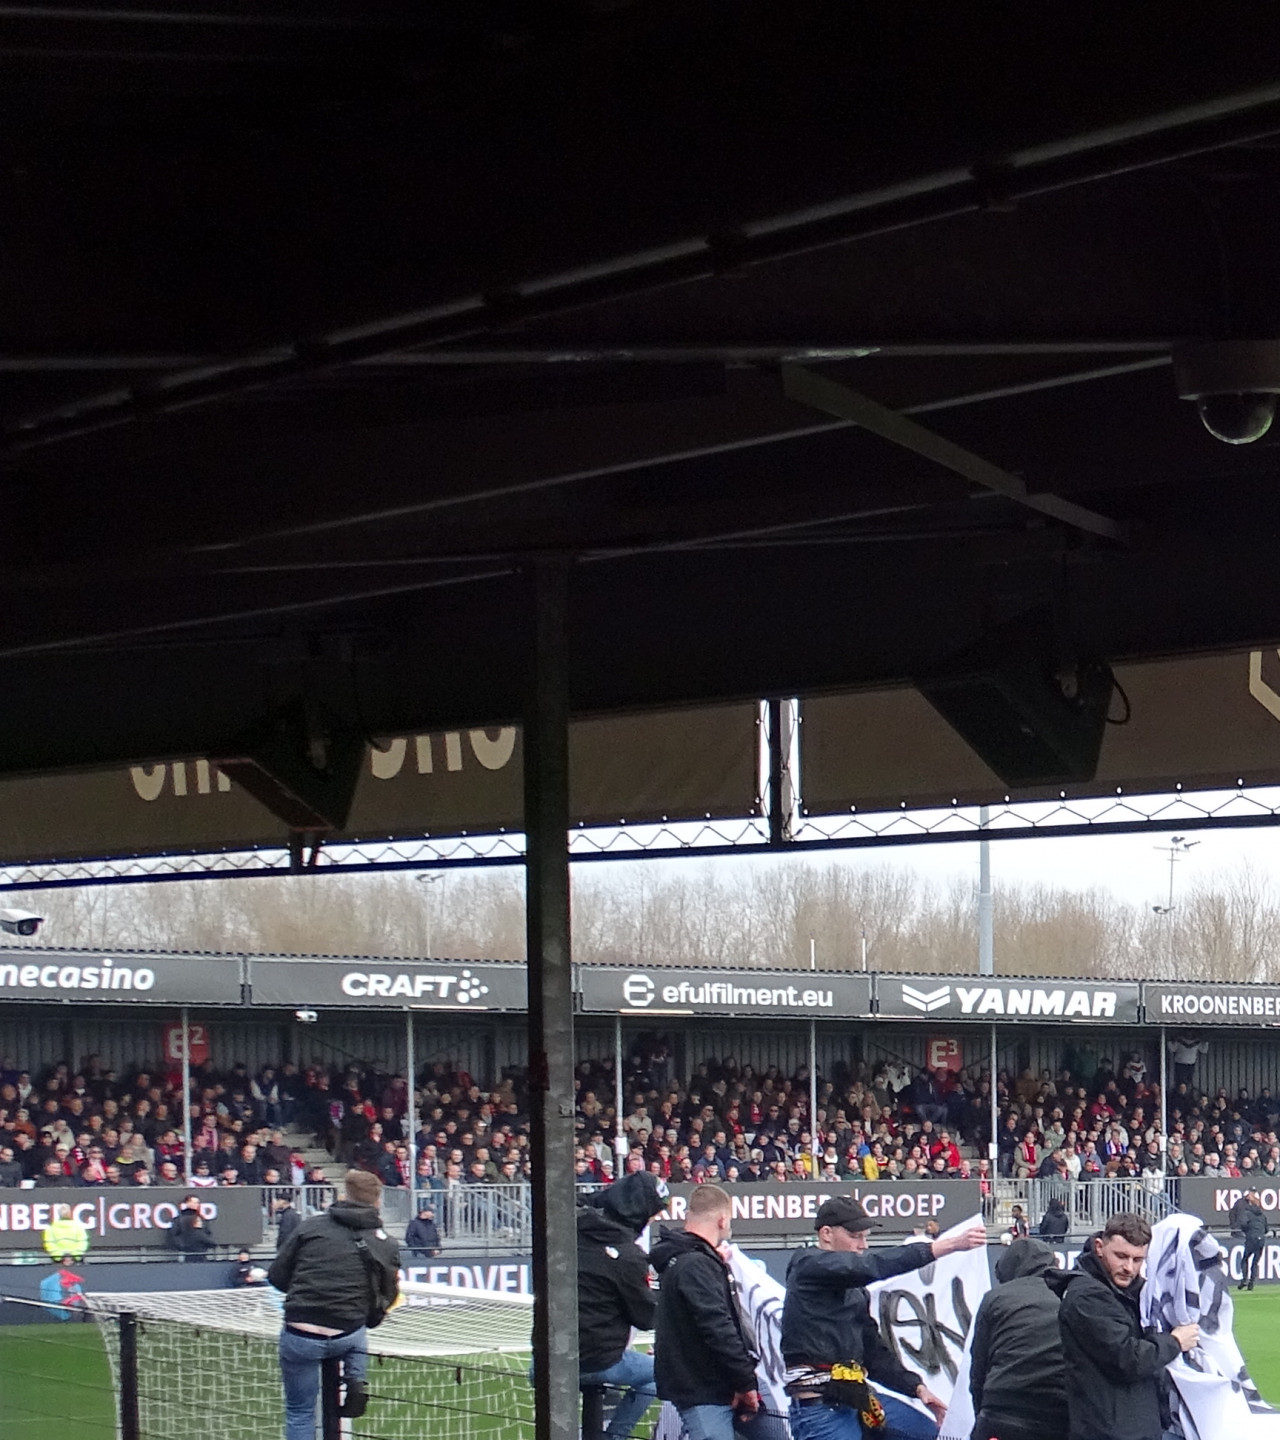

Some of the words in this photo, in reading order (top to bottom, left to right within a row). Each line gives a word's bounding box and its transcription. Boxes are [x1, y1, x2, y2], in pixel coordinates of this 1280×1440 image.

[341, 972, 458, 998] CRAFT
[662, 981, 834, 1008] efulfilment.eu
[955, 987, 1118, 1018] YANMAR
[0, 1203, 97, 1231] BEG
[108, 1203, 218, 1229] GROP
[861, 1193, 946, 1217] GROEP
